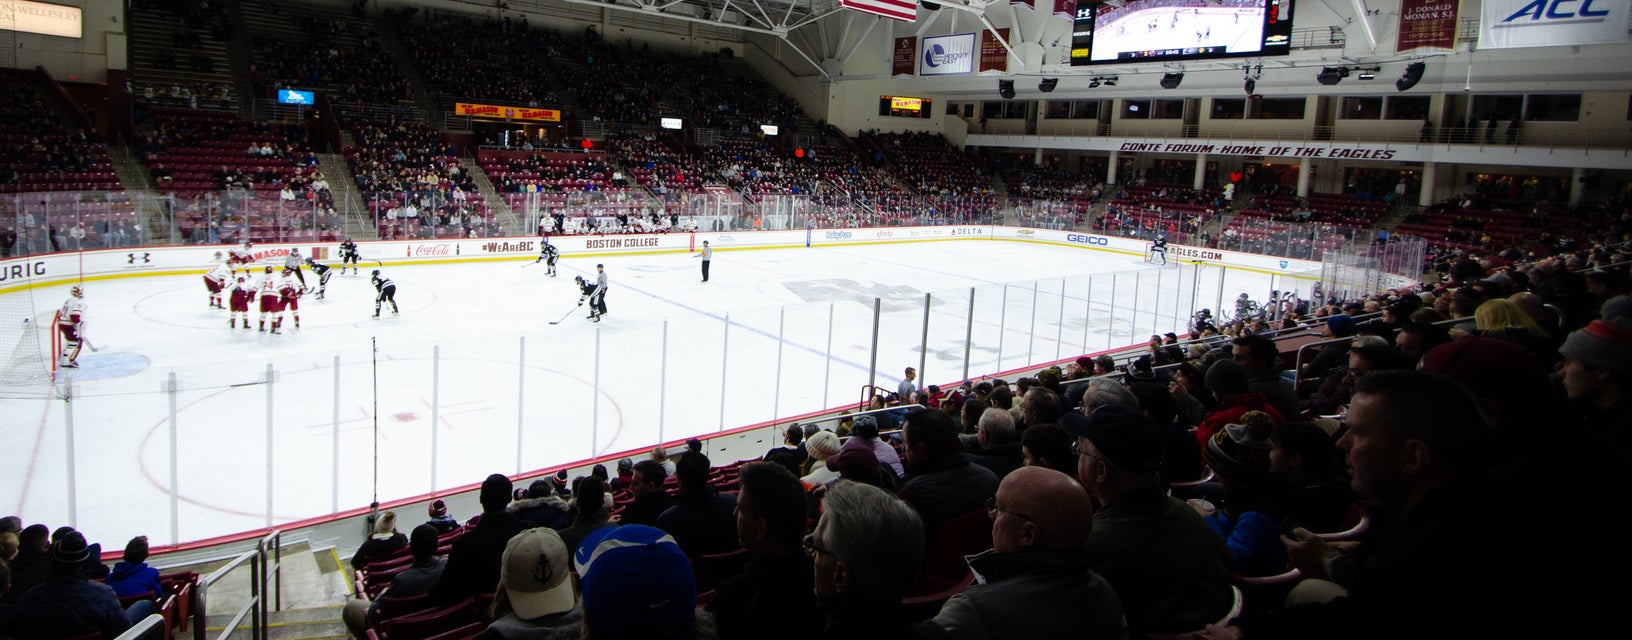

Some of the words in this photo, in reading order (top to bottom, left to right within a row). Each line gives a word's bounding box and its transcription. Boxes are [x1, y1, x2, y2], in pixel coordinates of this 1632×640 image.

[1416, 4, 1452, 13] DONALD
[1501, 0, 1610, 22] ACC
[1120, 142, 1162, 152] CONTE
[1164, 143, 1215, 154] FORUM
[1220, 145, 1266, 155] HOME
[1268, 146, 1292, 156] OF
[1294, 147, 1325, 157] THE
[1328, 148, 1396, 160] EAGLES
[957, 227, 983, 235] DELTA
[586, 238, 622, 249] BOSTON
[624, 237, 659, 248] COLLEGE
[1067, 233, 1108, 246] GEICO
[1168, 247, 1222, 261] AGLES.COM
